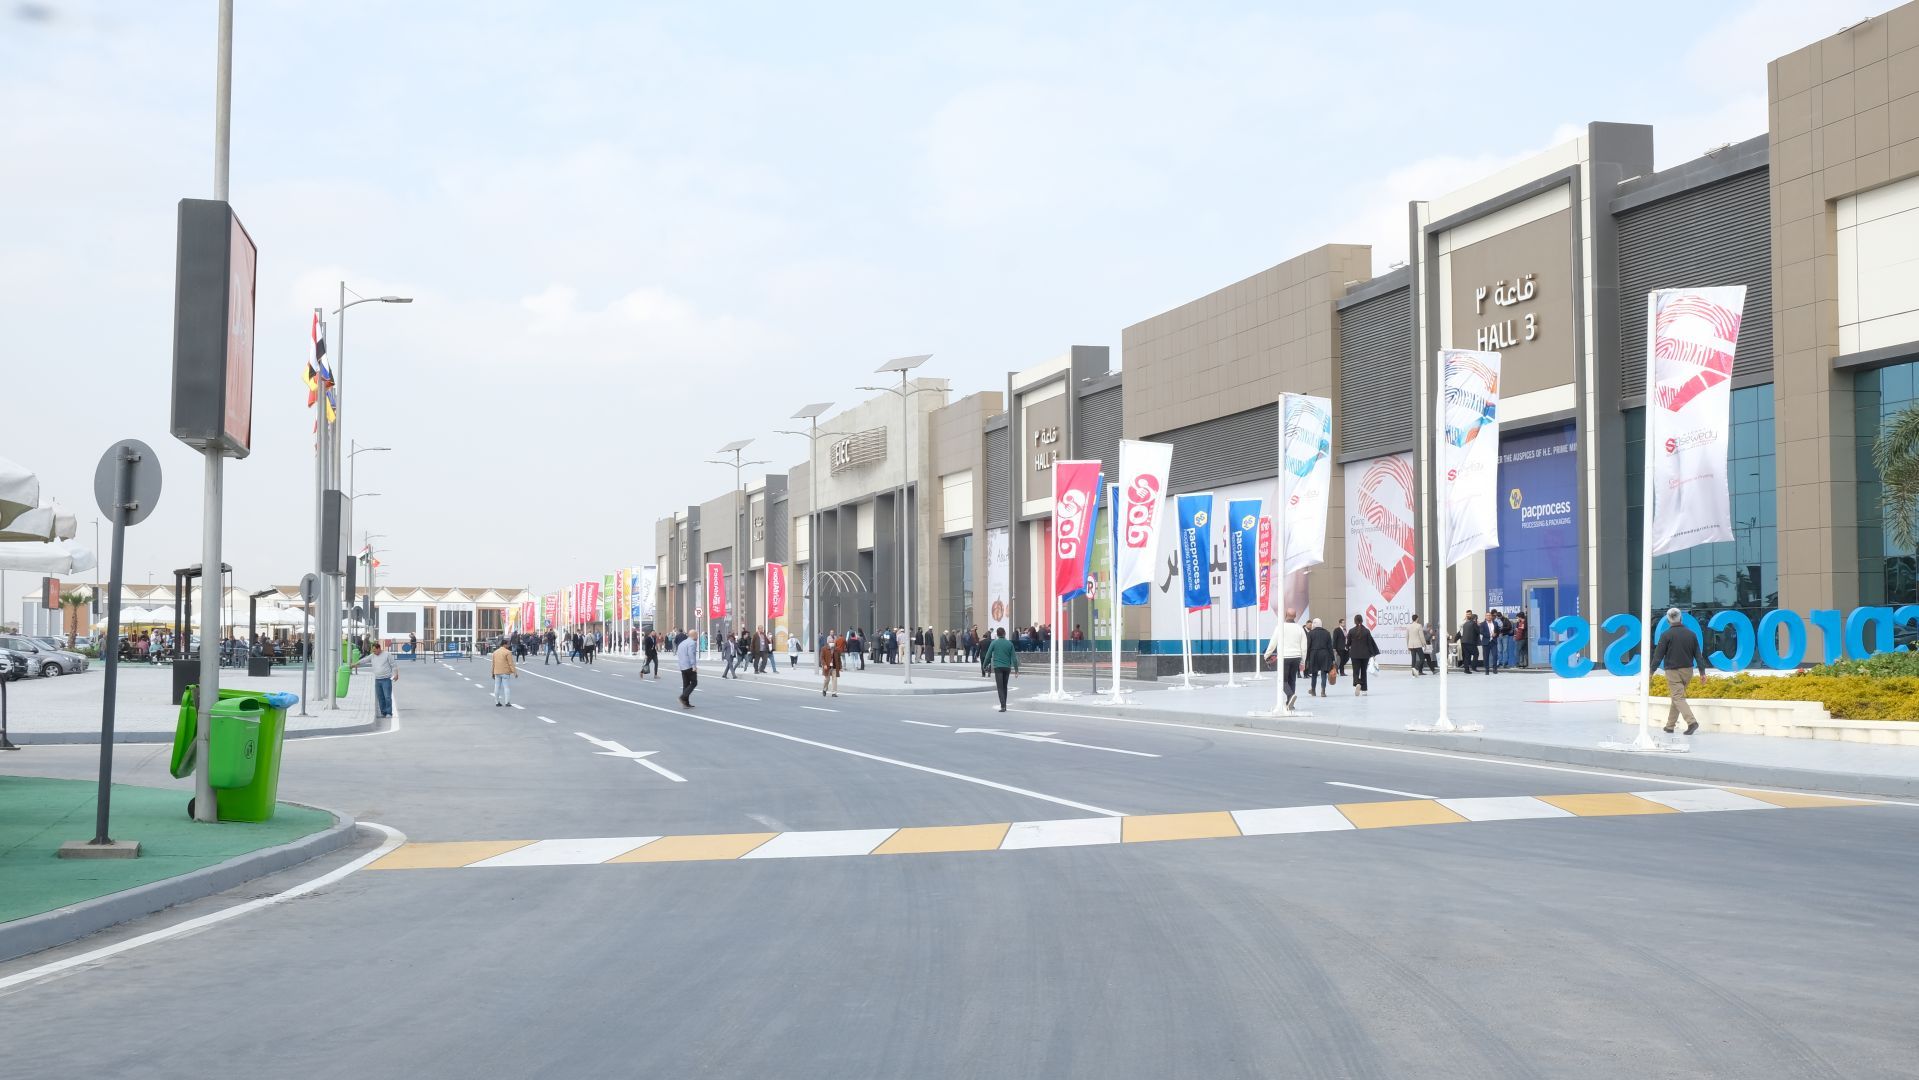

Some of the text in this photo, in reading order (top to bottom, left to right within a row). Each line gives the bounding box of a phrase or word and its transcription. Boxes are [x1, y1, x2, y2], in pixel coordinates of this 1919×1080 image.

[1476, 273, 1534, 314] قاعة ٣
[1477, 313, 1535, 352] HALL 3
[1034, 451, 1050, 471] HALL
[1504, 454, 1513, 463] THE
[1513, 450, 1535, 462] AUSPICES
[1536, 448, 1542, 457] OF
[1553, 444, 1569, 454] PRIME
[1521, 501, 1571, 521] pacprocess
[1187, 527, 1201, 591] pacprocess
[1234, 530, 1246, 592] pacprocess
